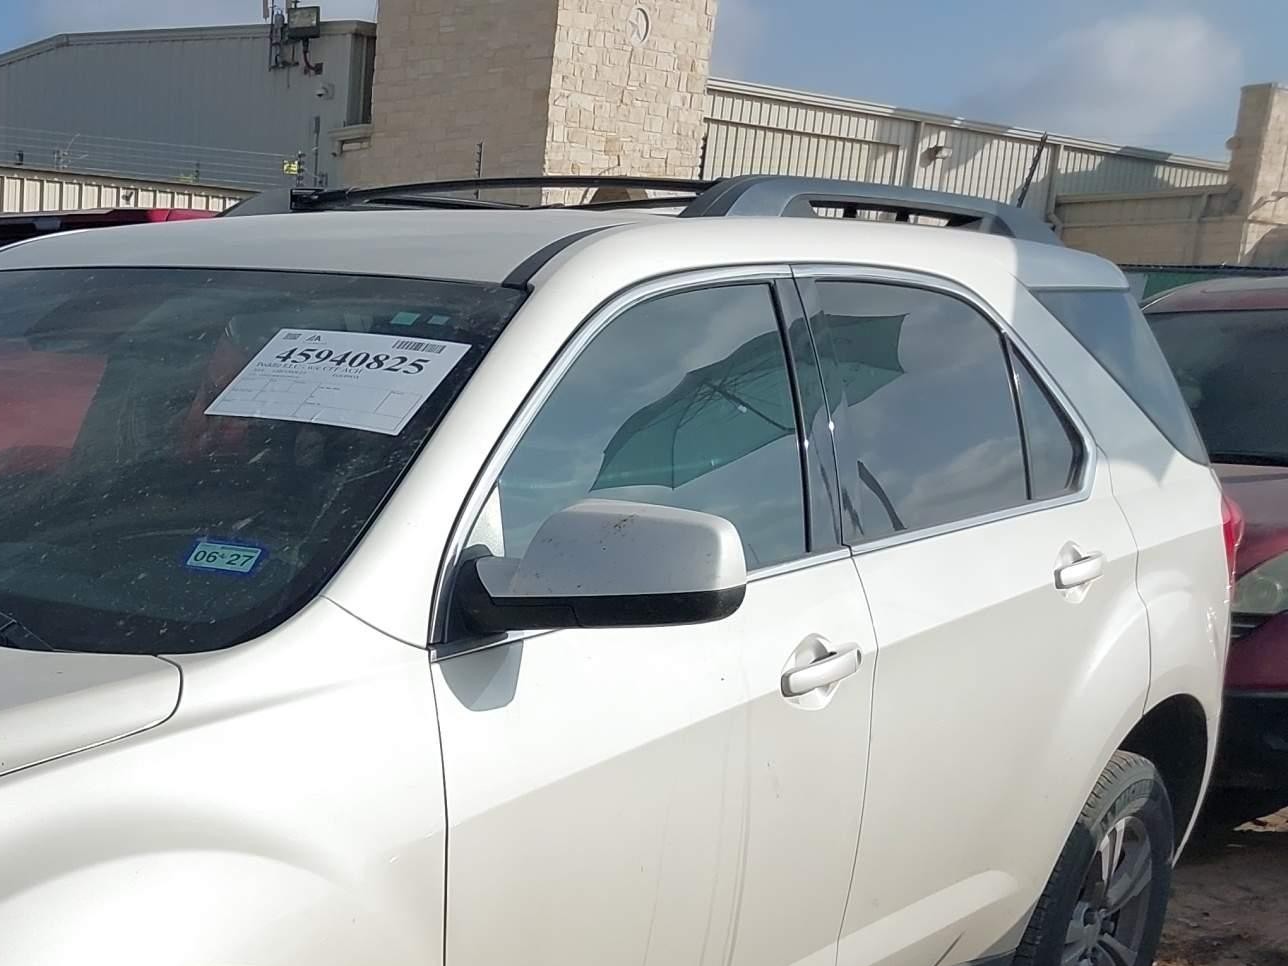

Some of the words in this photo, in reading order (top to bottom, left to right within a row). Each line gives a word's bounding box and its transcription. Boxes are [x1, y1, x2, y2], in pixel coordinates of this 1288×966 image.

[275, 346, 431, 375] 45940825
[194, 550, 219, 563] 06
[226, 553, 254, 567] 27
